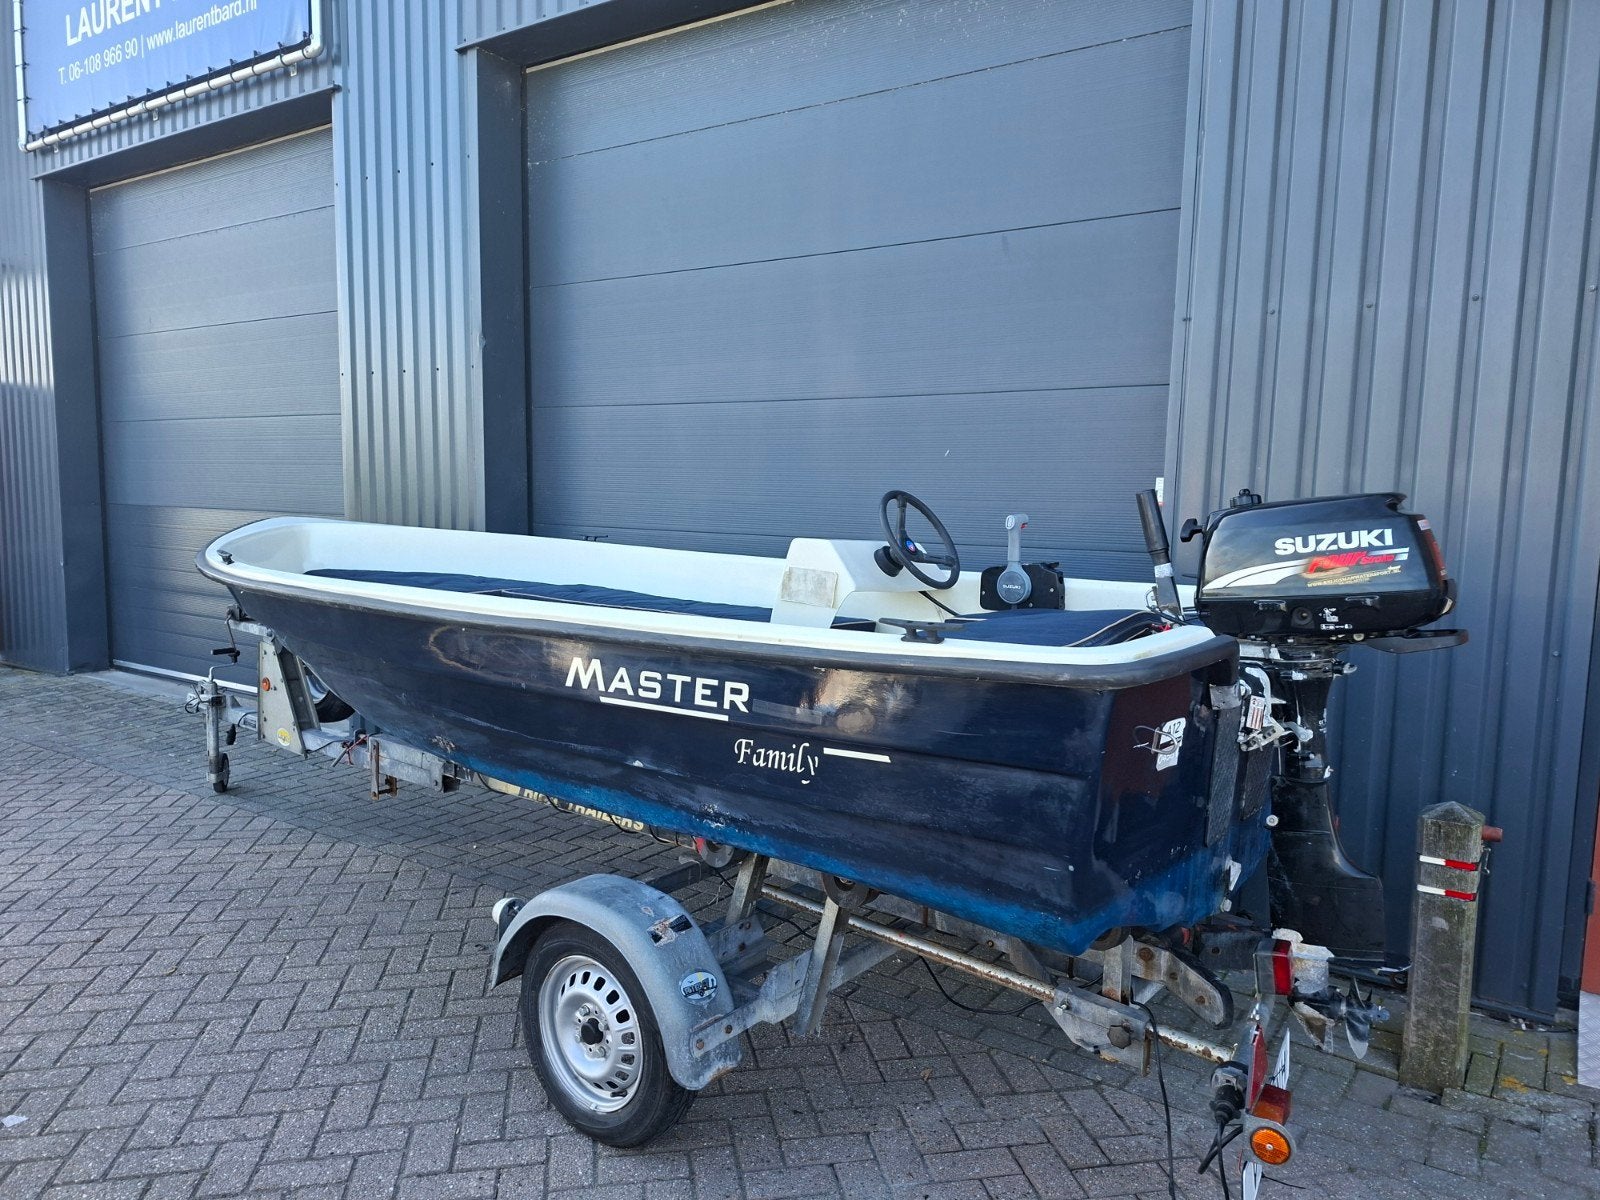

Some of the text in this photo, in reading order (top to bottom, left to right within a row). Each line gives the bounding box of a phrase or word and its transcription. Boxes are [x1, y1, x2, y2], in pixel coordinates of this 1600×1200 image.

[65, 0, 161, 47] LAURE
[58, 67, 67, 85] T.
[68, 52, 102, 82] 06-108
[103, 43, 123, 68] 966
[124, 37, 138, 60] 90
[1274, 528, 1394, 556] SUZUKI
[565, 656, 750, 714] MASTER
[734, 738, 820, 785] Family
